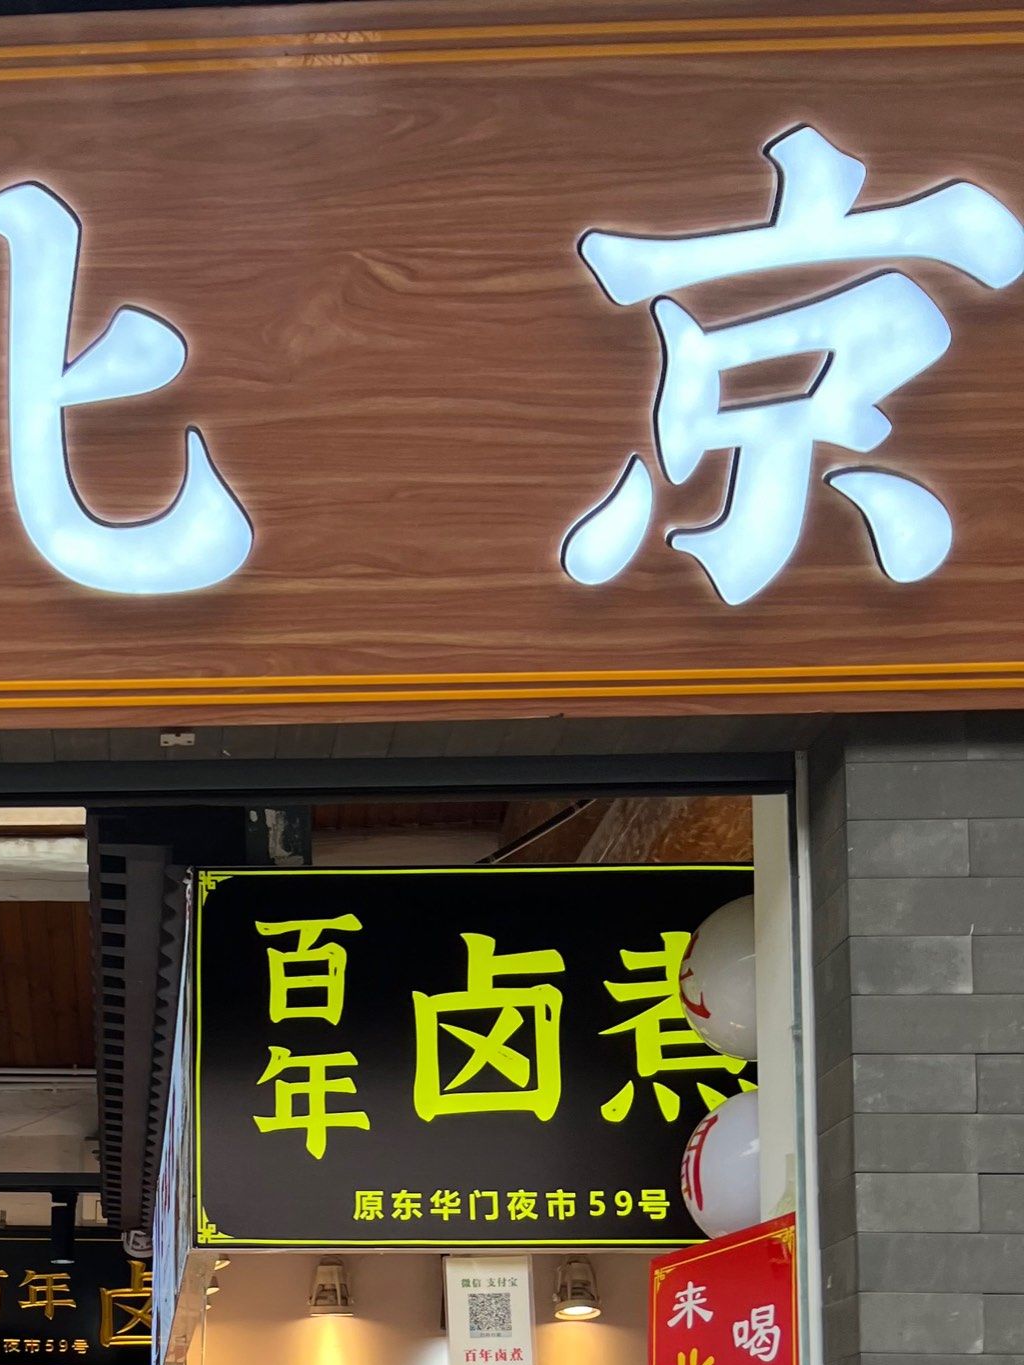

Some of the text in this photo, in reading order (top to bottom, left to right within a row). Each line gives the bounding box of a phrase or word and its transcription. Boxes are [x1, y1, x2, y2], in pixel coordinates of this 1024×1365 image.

[253, 913, 370, 1160] 百年
[412, 931, 758, 1123] 卤煮
[353, 1189, 671, 1221] 原东华门夜市59号
[487, 1277, 518, 1288] 支付宝
[464, 1348, 524, 1362] 百年卤煮
